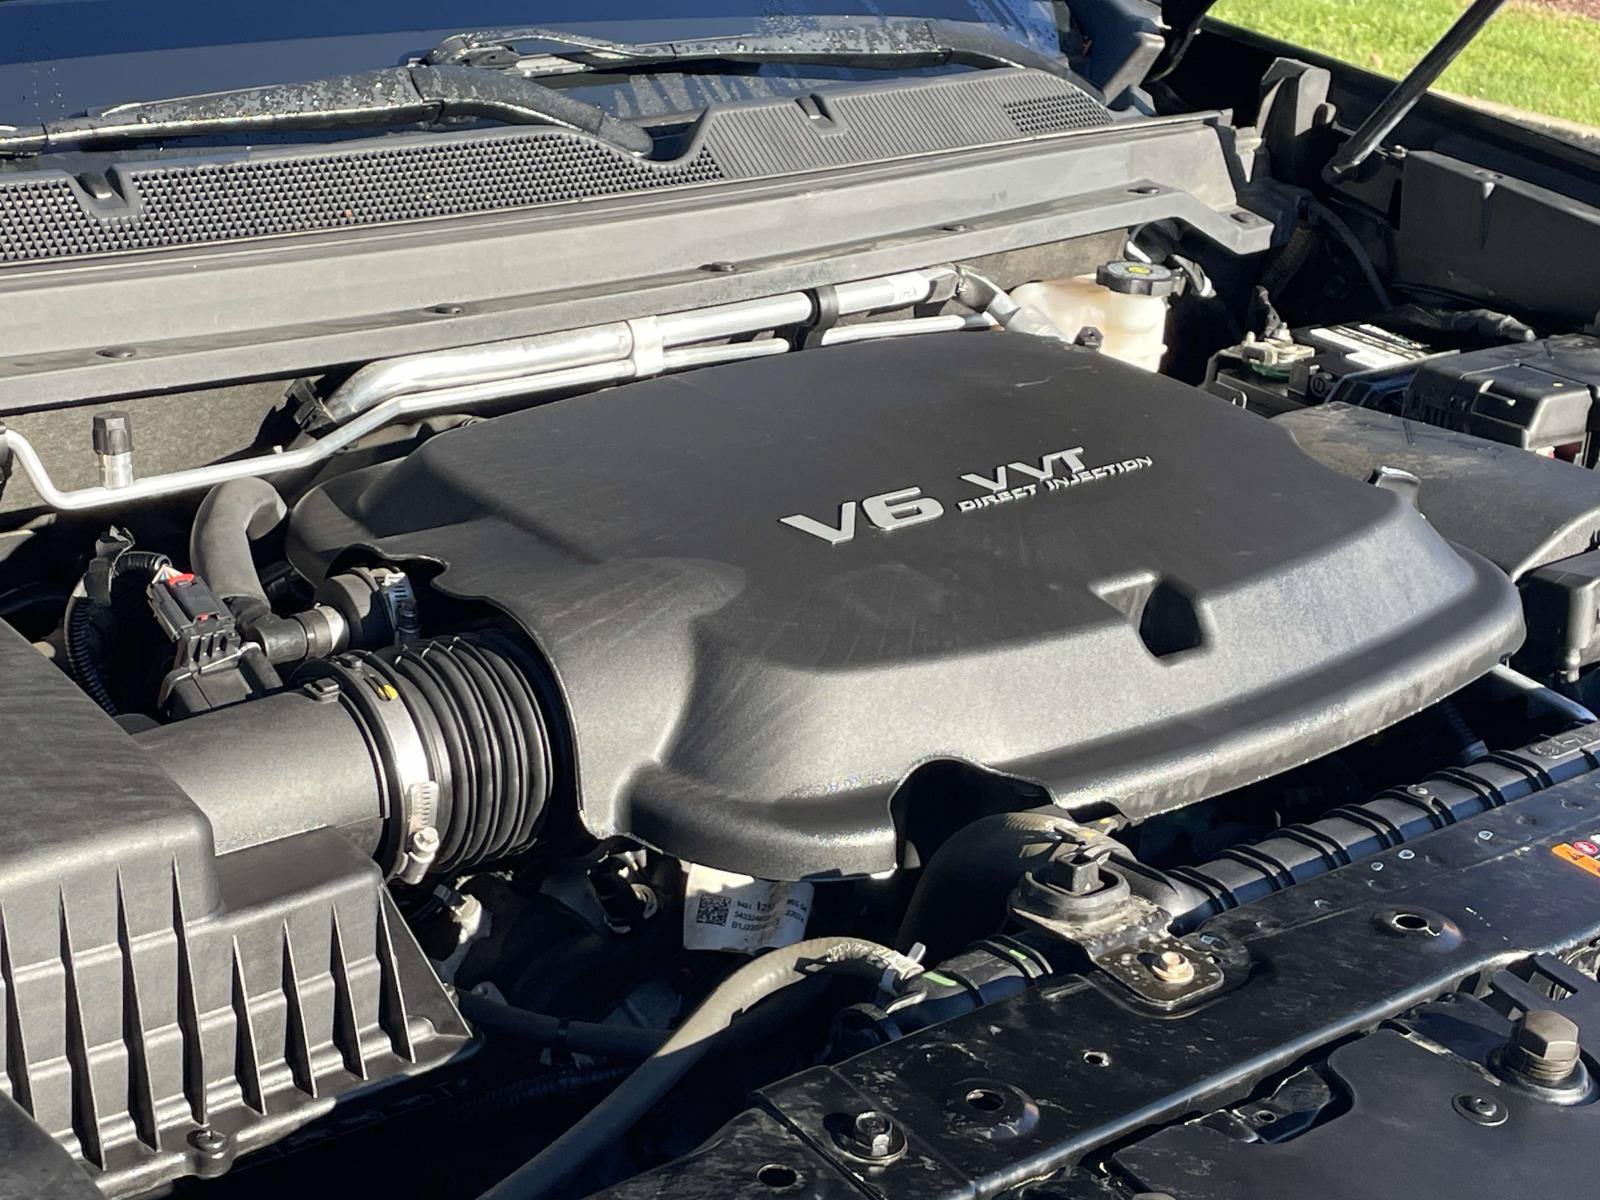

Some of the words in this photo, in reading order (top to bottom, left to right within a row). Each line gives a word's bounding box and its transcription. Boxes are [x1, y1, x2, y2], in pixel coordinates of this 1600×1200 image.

[780, 486, 945, 546] V6
[960, 446, 1084, 493] VVT
[956, 484, 1037, 513] DIRECT
[1045, 455, 1153, 491] INJECTION
